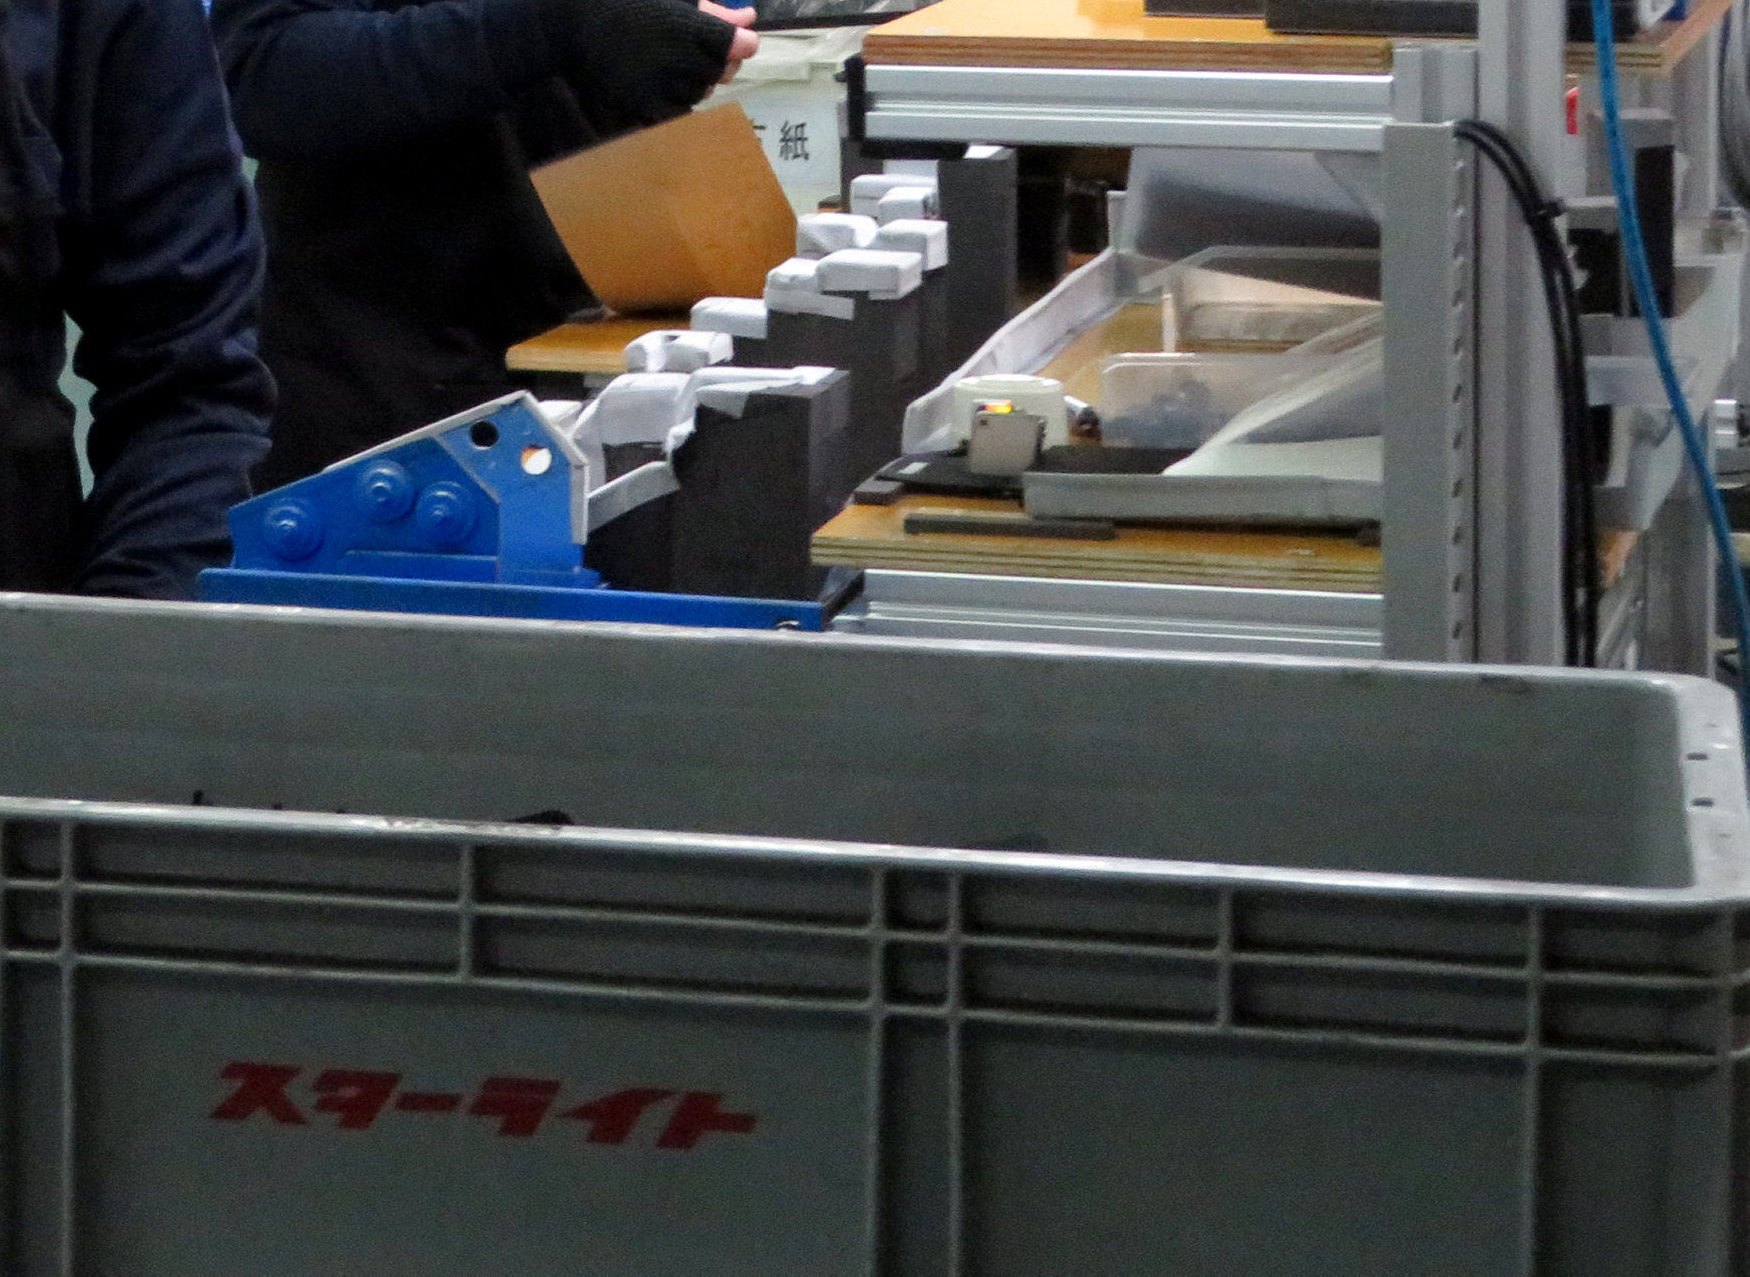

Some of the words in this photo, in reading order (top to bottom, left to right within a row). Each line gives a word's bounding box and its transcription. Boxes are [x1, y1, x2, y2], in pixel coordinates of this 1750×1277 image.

[753, 120, 810, 161] 紙
[208, 1061, 758, 1149] スターライト
